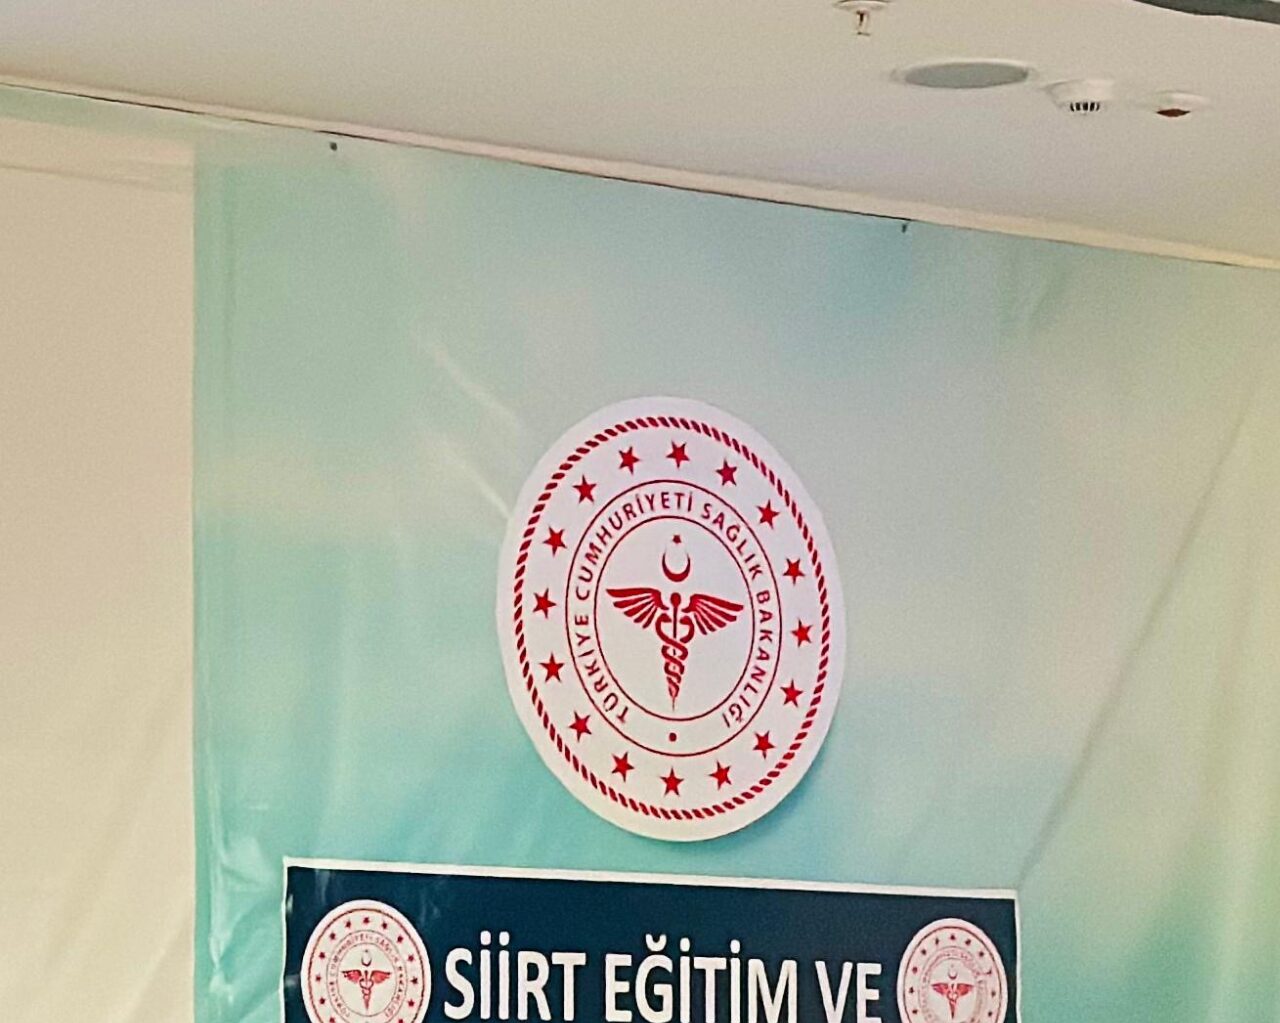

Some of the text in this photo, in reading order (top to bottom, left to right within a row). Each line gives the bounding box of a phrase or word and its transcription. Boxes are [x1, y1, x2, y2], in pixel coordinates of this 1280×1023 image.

[573, 491, 773, 730] TÜRKİYE CUMHURİYETİ SAĞLIK BAKANLIĞI
[444, 930, 587, 1022] SİİRT
